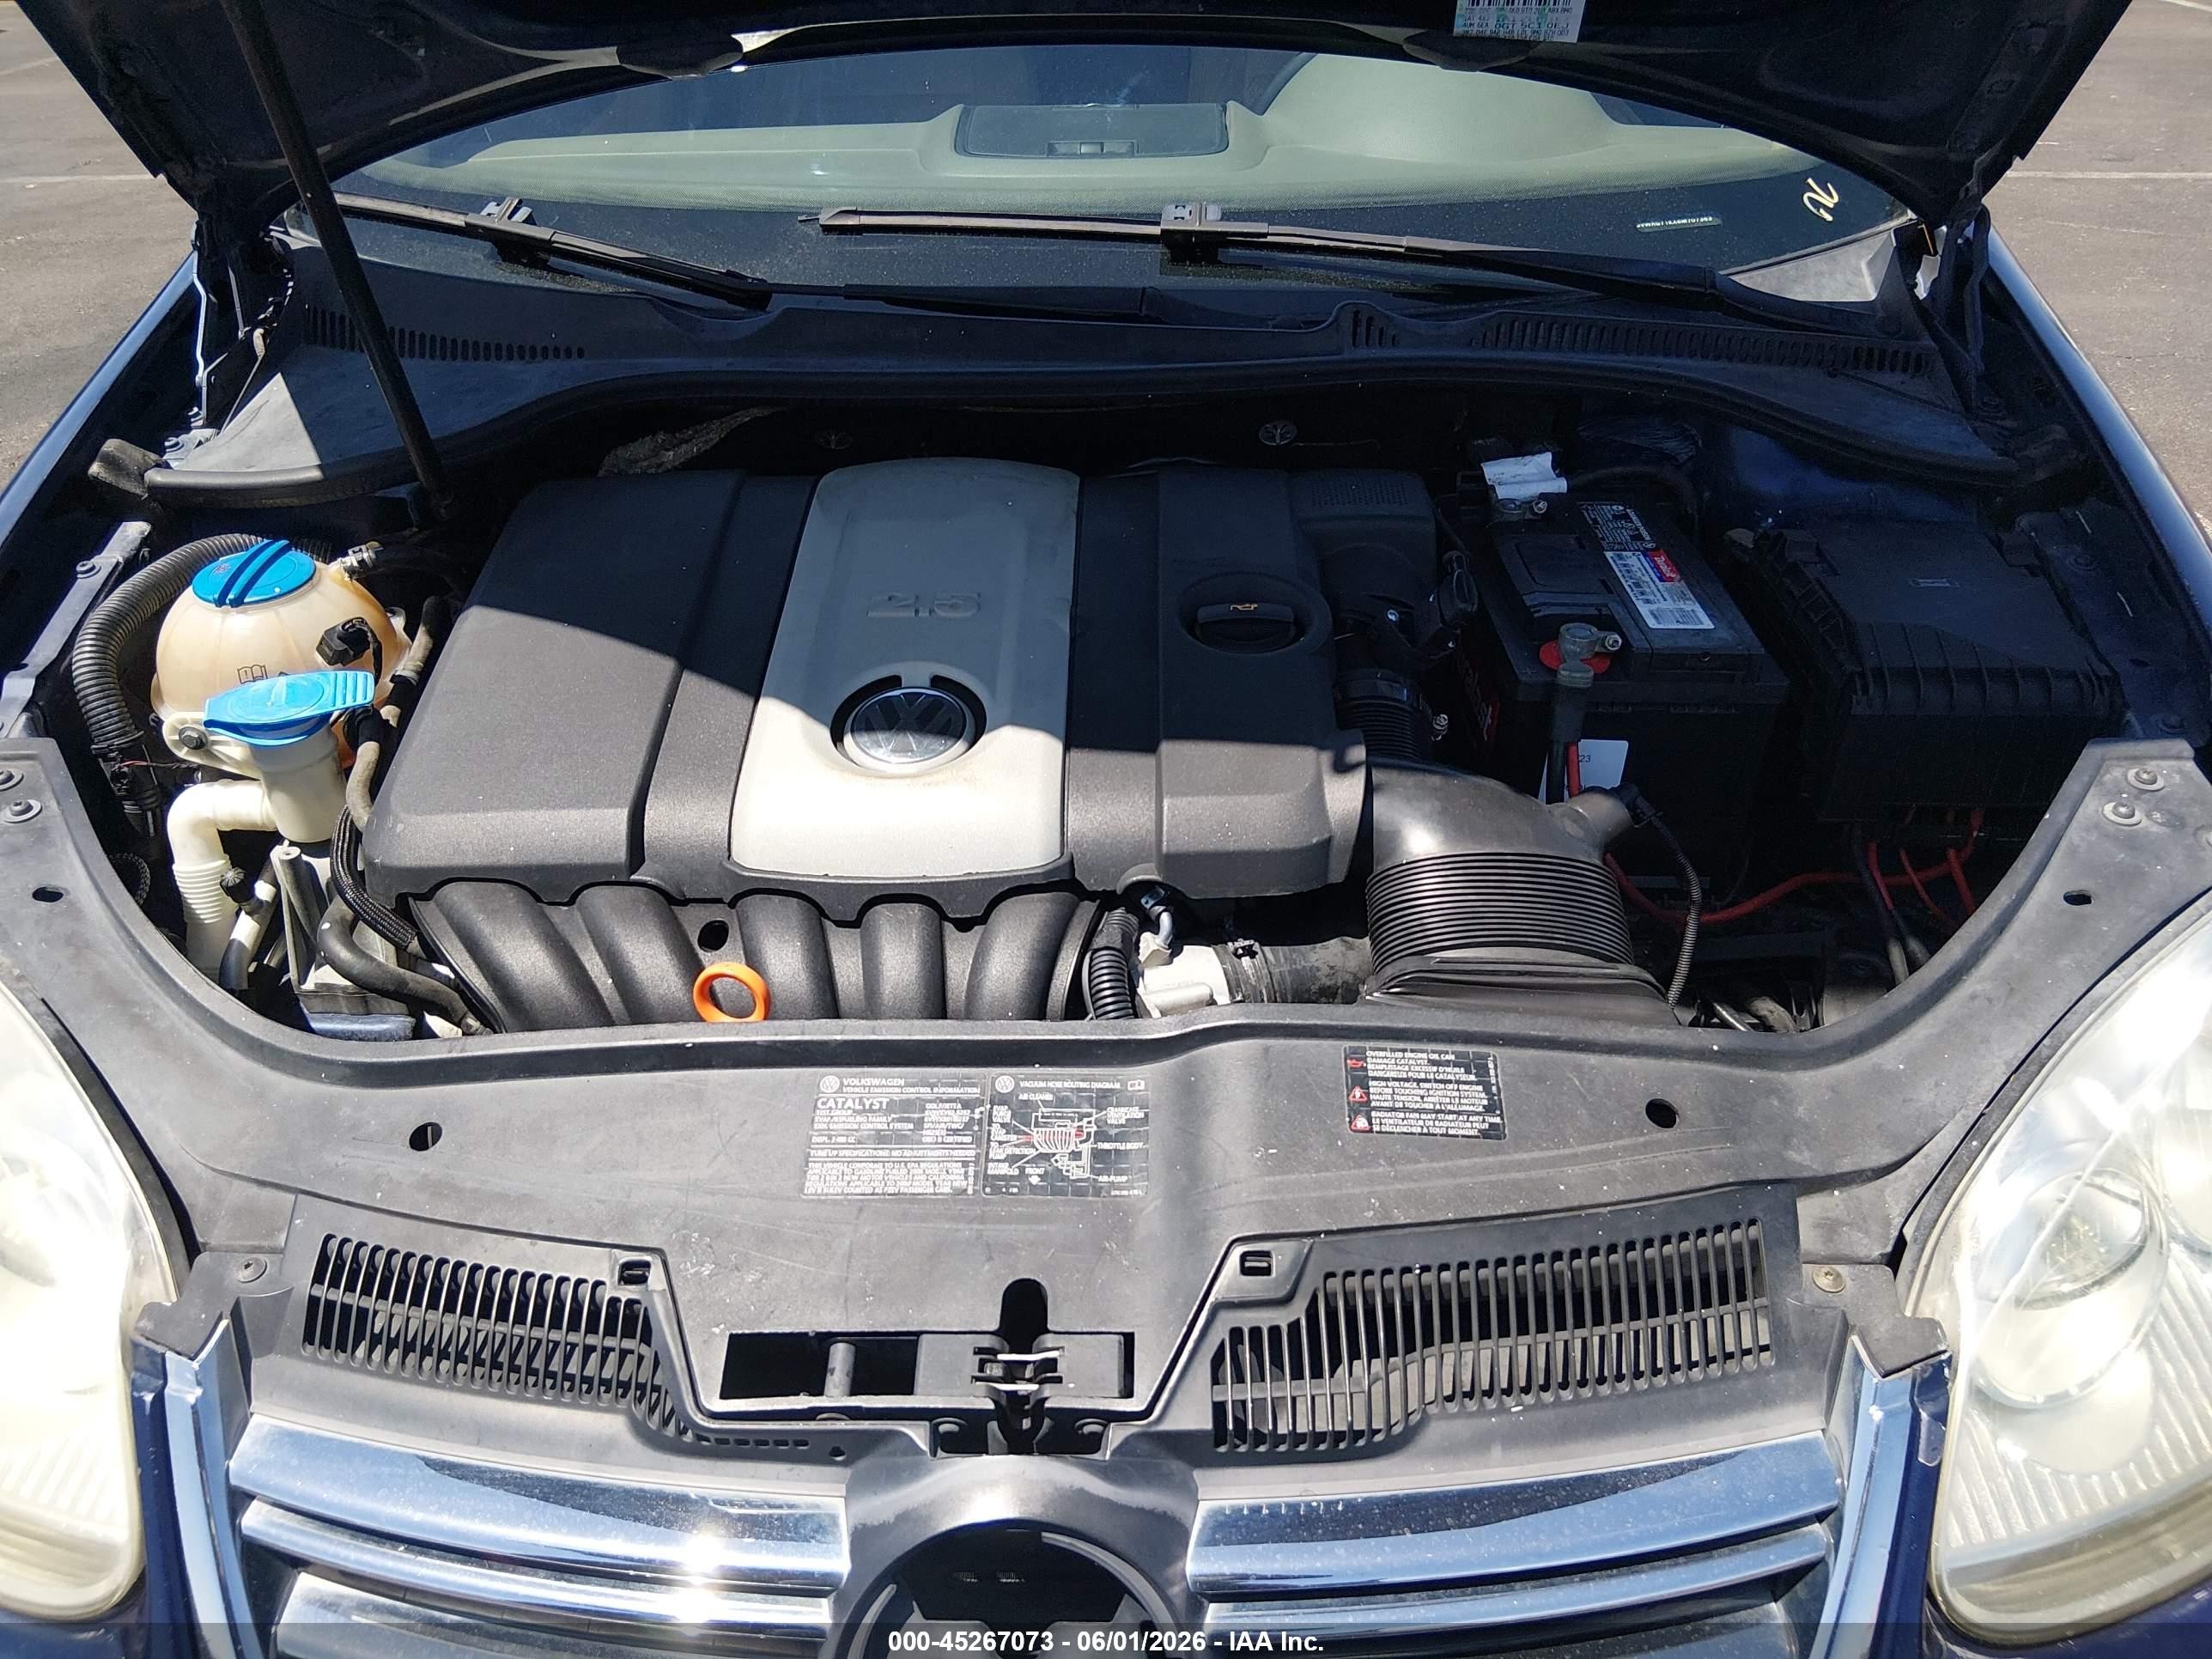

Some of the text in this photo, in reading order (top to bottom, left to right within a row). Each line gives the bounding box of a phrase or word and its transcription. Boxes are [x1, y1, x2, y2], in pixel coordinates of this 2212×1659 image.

[842, 1078, 905, 1086] VOLKSWAGEN
[817, 1097, 890, 1109] CATALYST
[1381, 1118, 1425, 1127] VENTILATEUR
[1435, 1120, 1472, 1128] RADIATEUR
